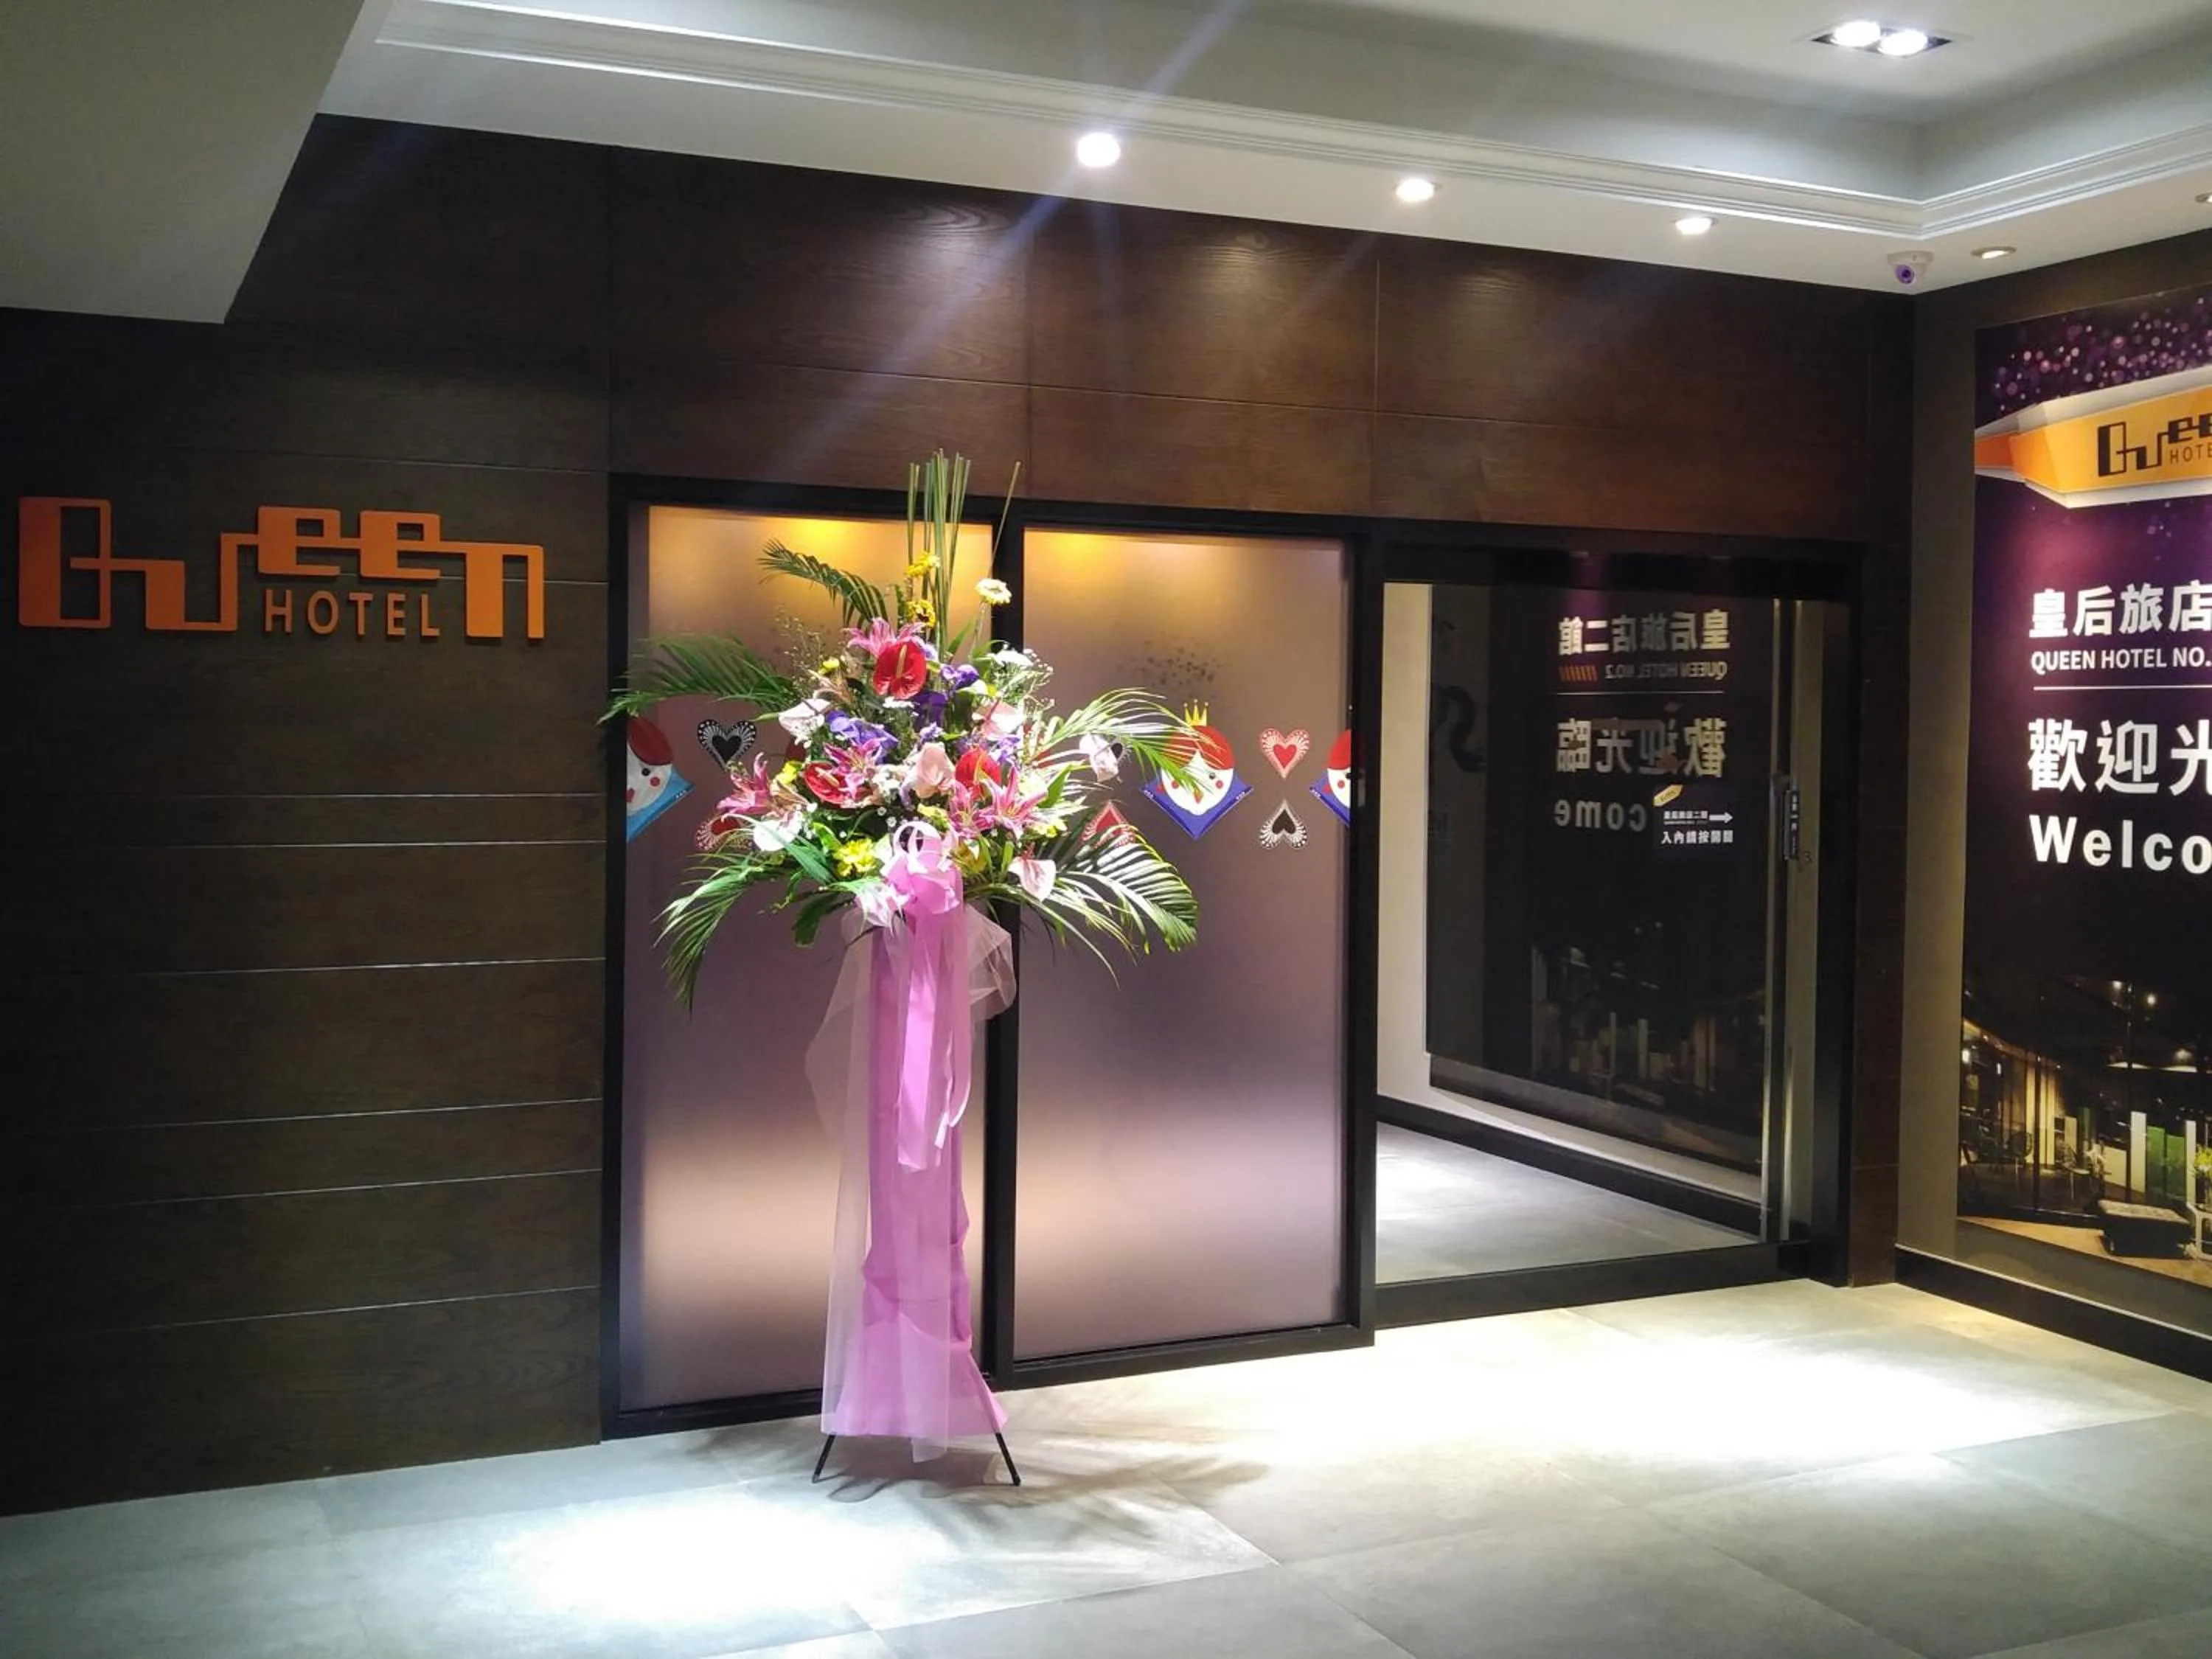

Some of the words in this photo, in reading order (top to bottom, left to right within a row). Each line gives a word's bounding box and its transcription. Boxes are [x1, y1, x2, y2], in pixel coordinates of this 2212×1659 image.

[264, 588, 440, 636] HOTEL
[2029, 580, 2212, 638] 皇后旅店
[2031, 650, 2096, 675] QUEEN
[2101, 647, 2167, 669] HOTEL
[2173, 646, 2212, 667] NO.
[2028, 718, 2212, 796] 歡迎光
[2029, 814, 2212, 874] Welco
